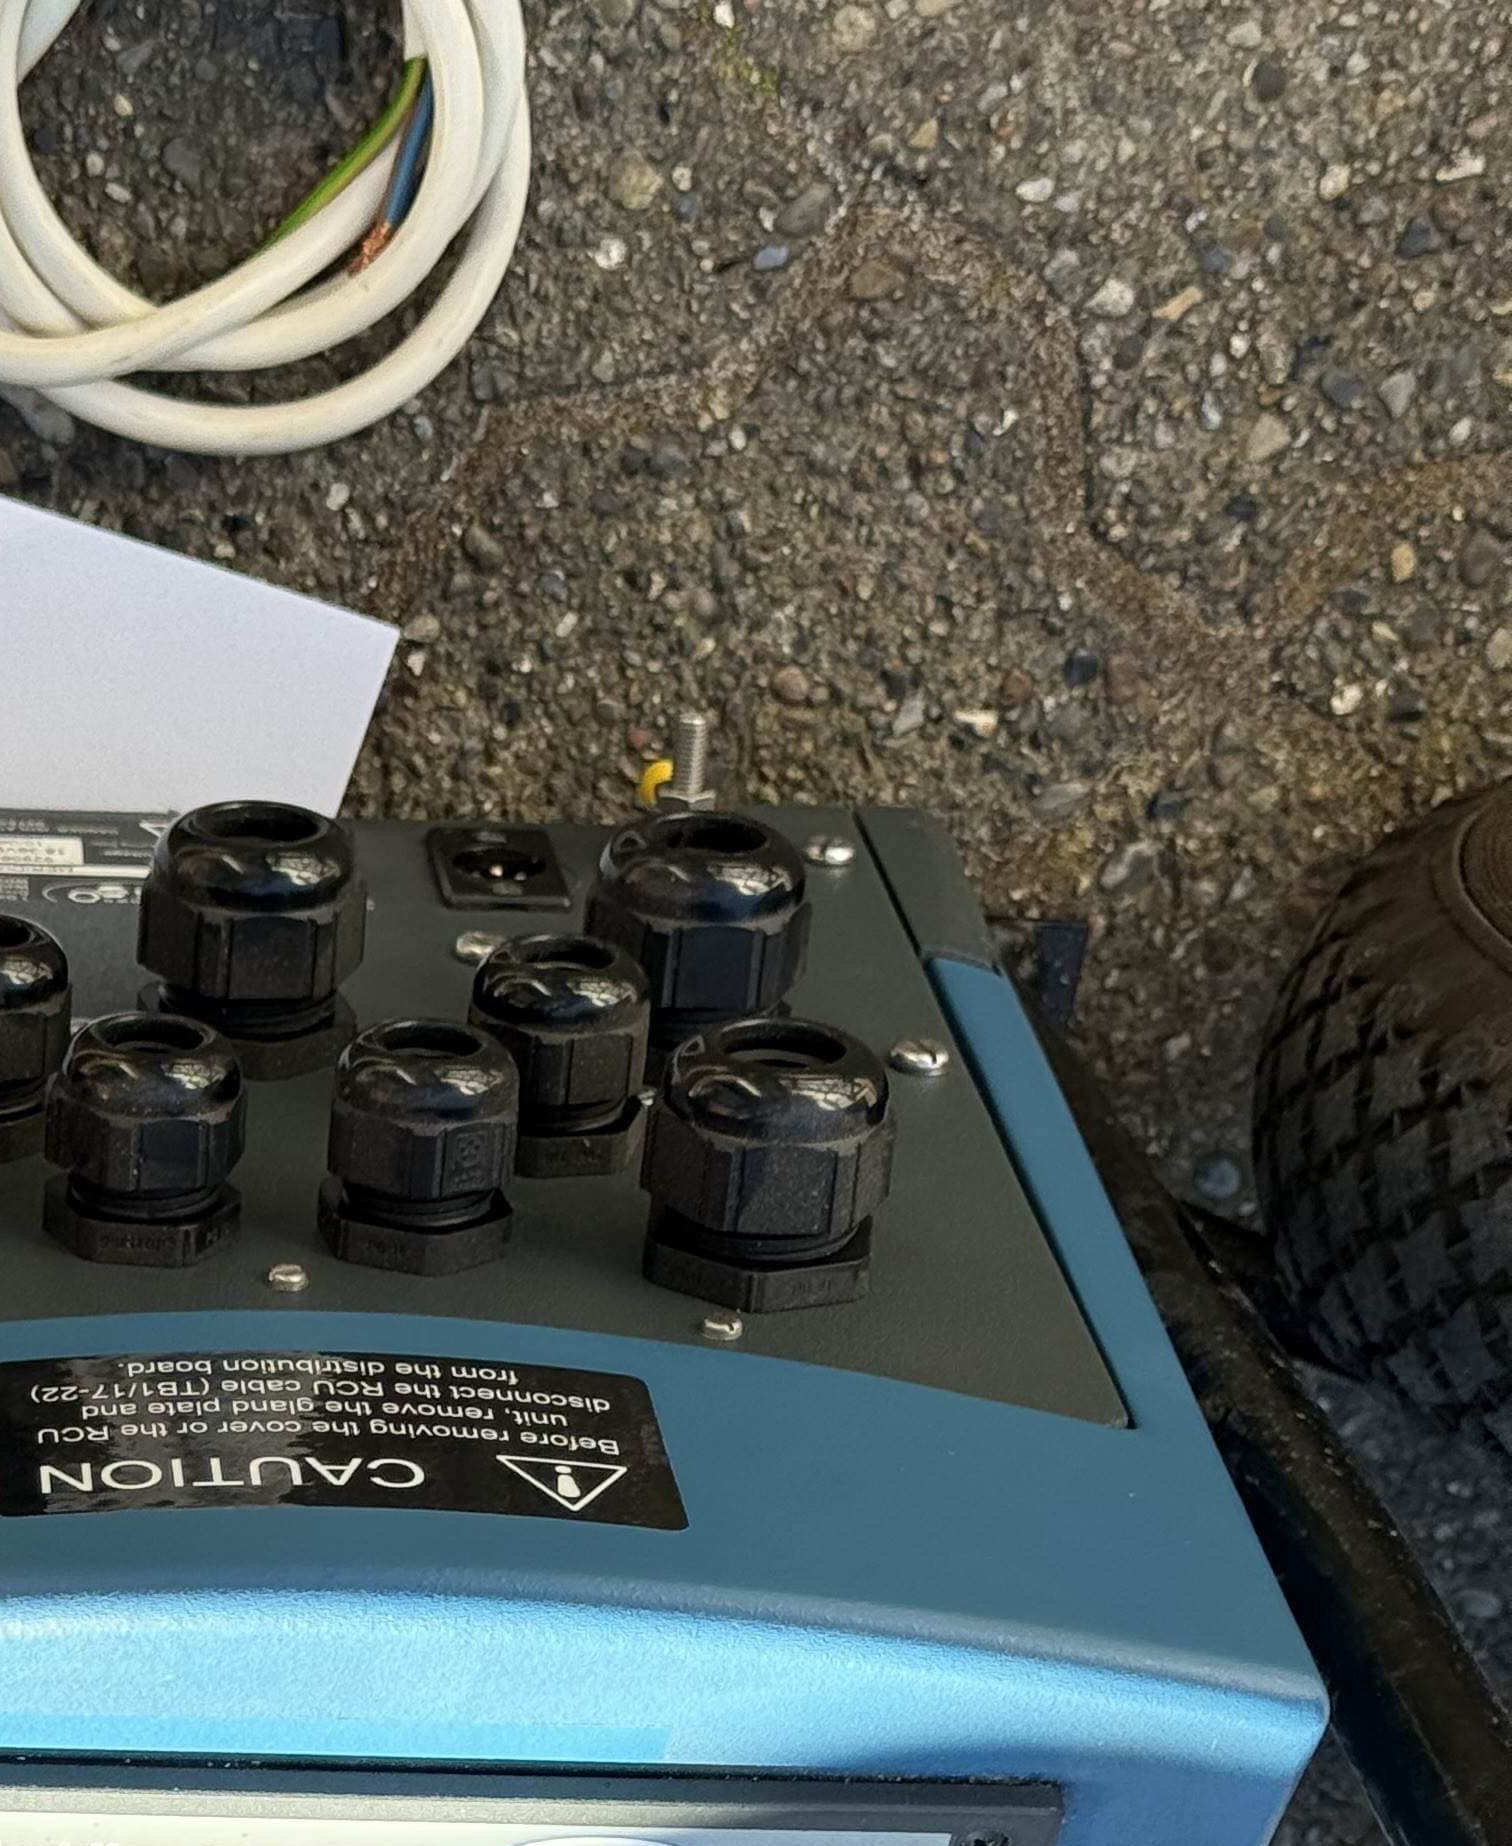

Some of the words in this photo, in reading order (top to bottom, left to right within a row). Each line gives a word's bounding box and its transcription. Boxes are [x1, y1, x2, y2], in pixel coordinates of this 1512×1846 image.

[118, 1360, 212, 1377] board.
[223, 1359, 385, 1376] distribution
[395, 1362, 441, 1379] the
[451, 1365, 519, 1385] from
[31, 1378, 210, 1403] (TB1/17-22)
[221, 1379, 301, 1393] cable
[313, 1380, 384, 1397] RCU
[394, 1382, 441, 1398] the
[147, 1398, 220, 1415] plate
[232, 1397, 314, 1414] gland
[450, 1385, 610, 1412] disconnect
[82, 1403, 137, 1420] and
[325, 1399, 372, 1416] the
[382, 1402, 494, 1420] remove
[217, 1420, 301, 1432] cover
[505, 1409, 568, 1427] unit,
[38, 1426, 109, 1444] RCU
[121, 1423, 168, 1437] the
[177, 1422, 208, 1433] or
[312, 1420, 360, 1436] the
[370, 1419, 510, 1441] removing
[520, 1430, 620, 1455] Before
[39, 1456, 425, 1494] CAUTION
